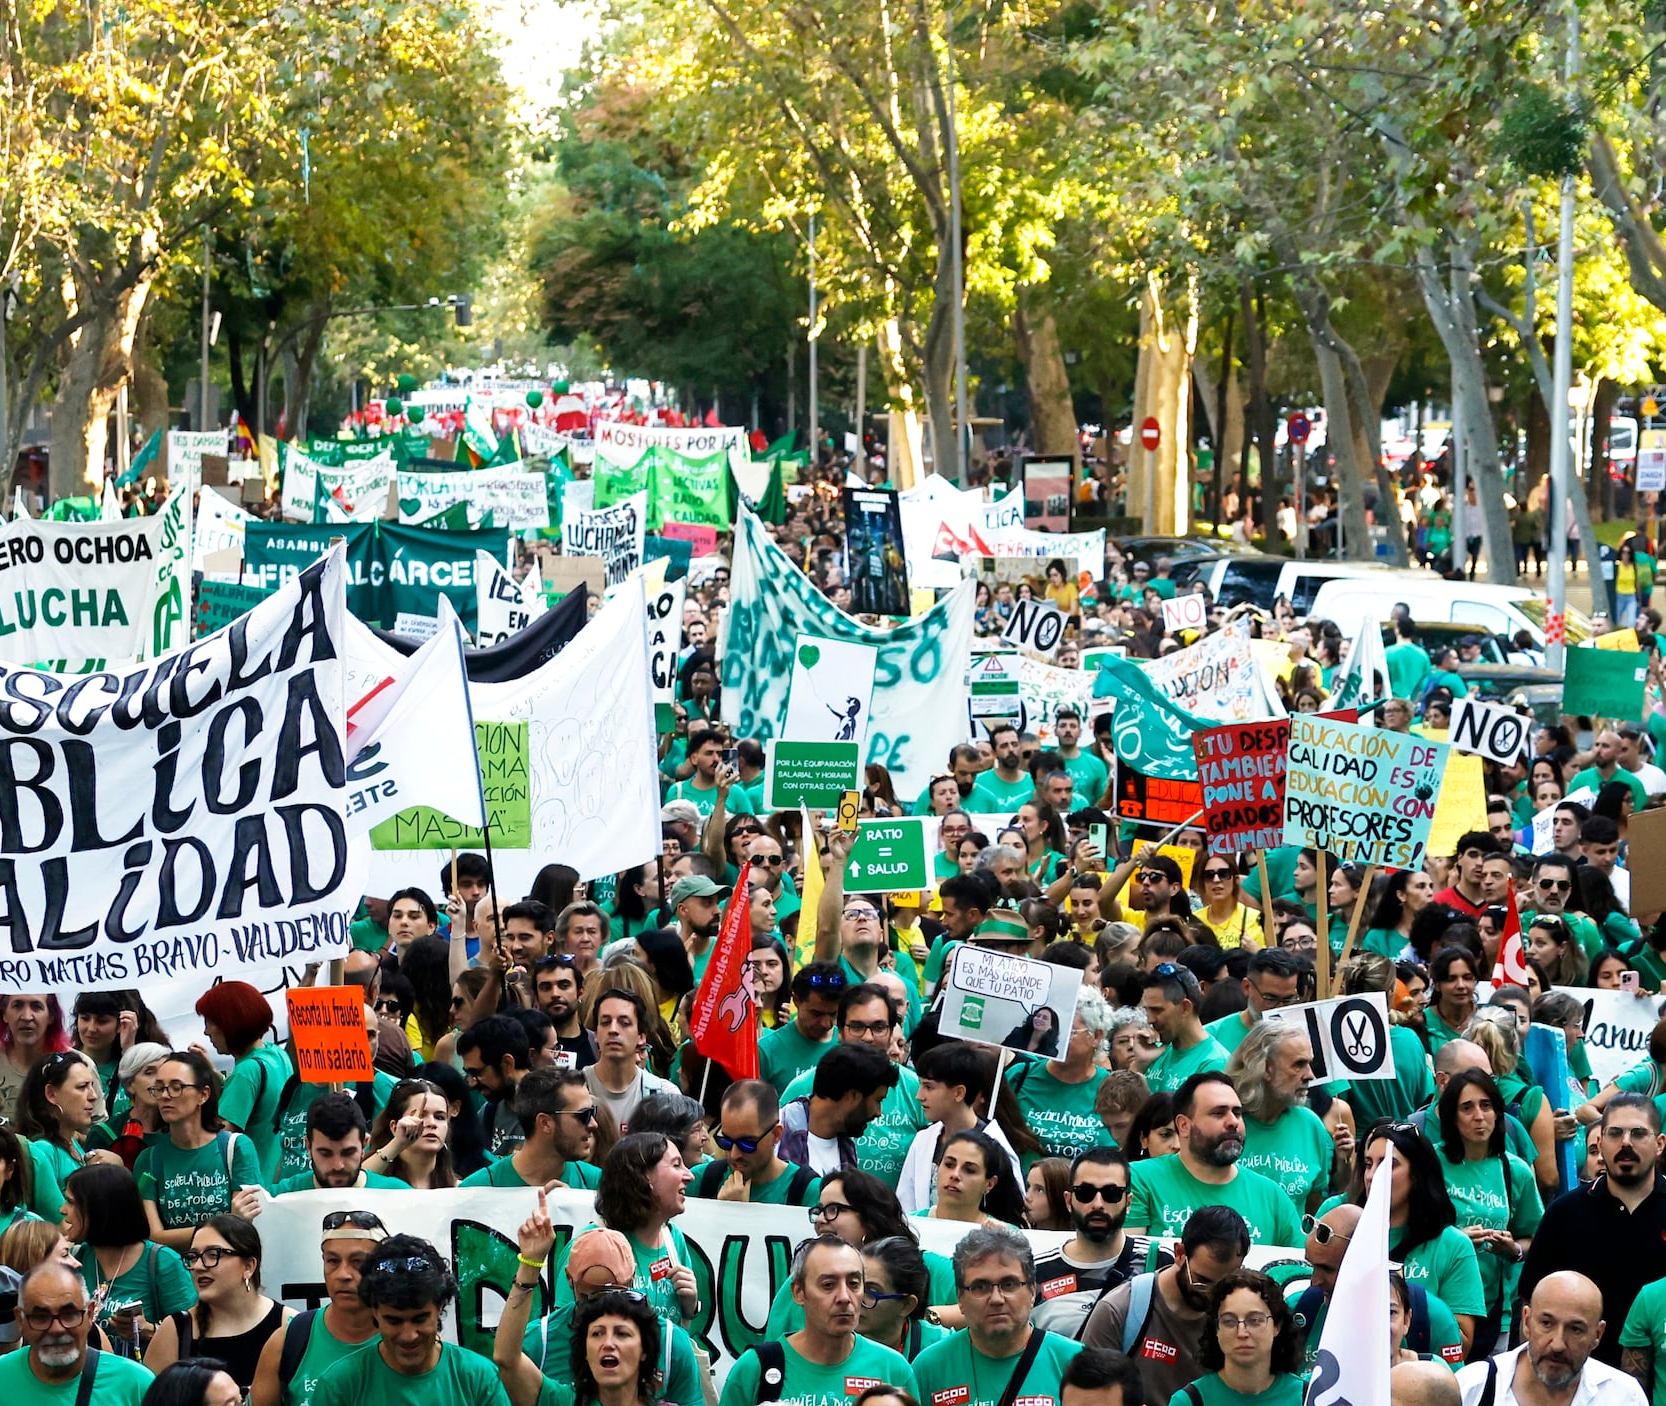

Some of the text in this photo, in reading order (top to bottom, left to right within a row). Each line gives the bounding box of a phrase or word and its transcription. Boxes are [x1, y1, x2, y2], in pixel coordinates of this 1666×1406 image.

[53, 534, 153, 565] OCHOA
[1004, 601, 1063, 651] NO
[1165, 597, 1202, 629] NO
[1454, 703, 1524, 759] NO
[776, 759, 790, 767] POR
[803, 759, 856, 768] EQUIPARACIÓN
[777, 770, 852, 779] SALARIAL Y HORARIA
[1289, 744, 1416, 788] CALIDAD ES
[1203, 782, 1254, 809] PONE
[1261, 782, 1277, 801] A
[1288, 770, 1435, 819] EDUCACIÓN CON
[1208, 803, 1281, 834] GRADOS
[1287, 796, 1413, 842] PROFESORES
[866, 828, 903, 842] RATIO
[867, 862, 909, 876] SALUD
[693, 953, 728, 1041] Sindicato de
[966, 976, 1034, 1000] QUE TU PATIO
[288, 996, 364, 1027] Recorta tu fraude,
[298, 1036, 370, 1072] no mi salario.
